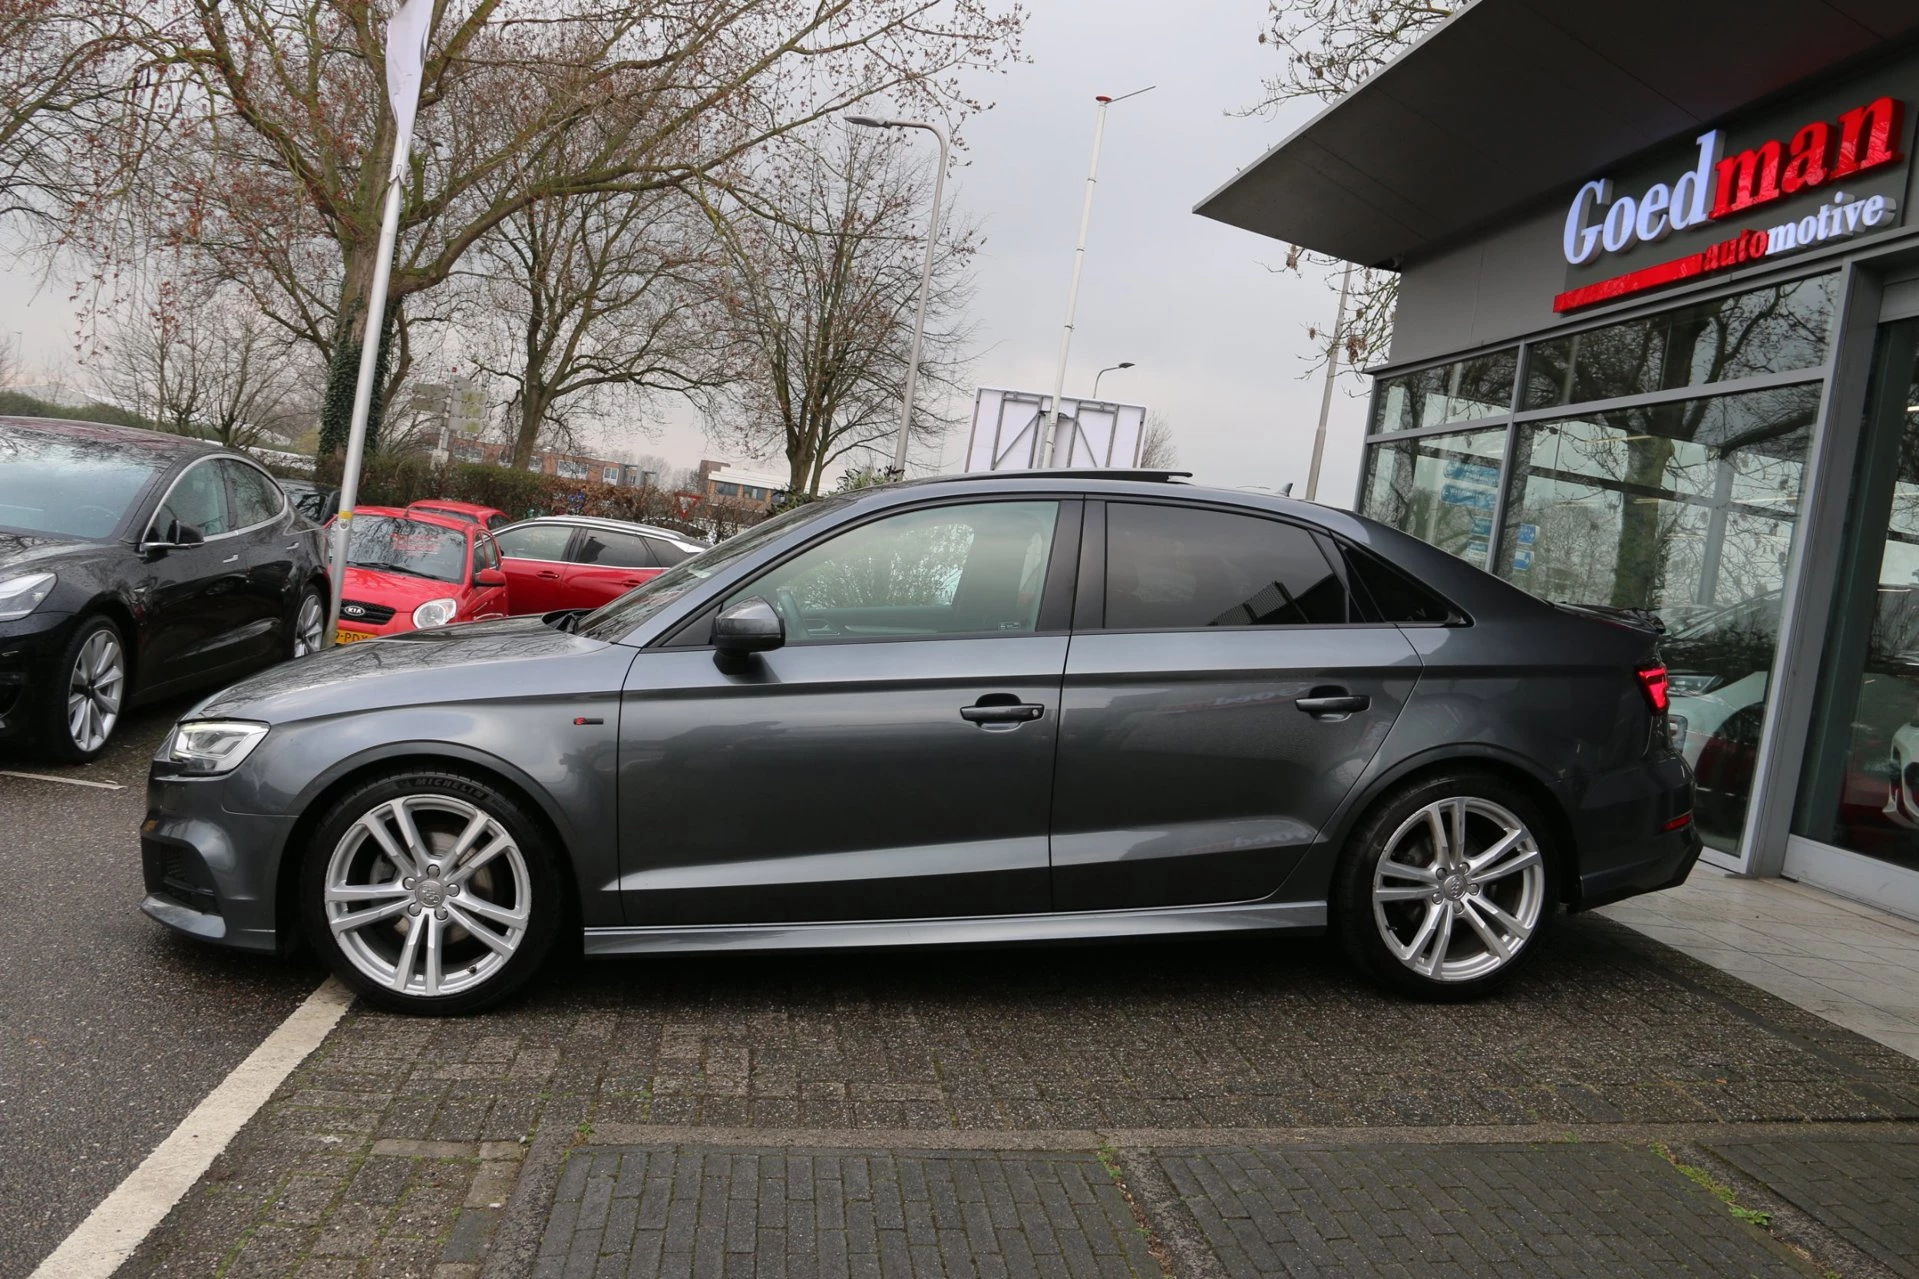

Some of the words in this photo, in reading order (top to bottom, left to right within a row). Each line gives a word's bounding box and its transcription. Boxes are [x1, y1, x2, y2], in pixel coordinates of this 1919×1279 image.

[1563, 96, 1899, 264] Goedman
[1704, 191, 1892, 271] automotive
[414, 777, 486, 800] MICHELIN
